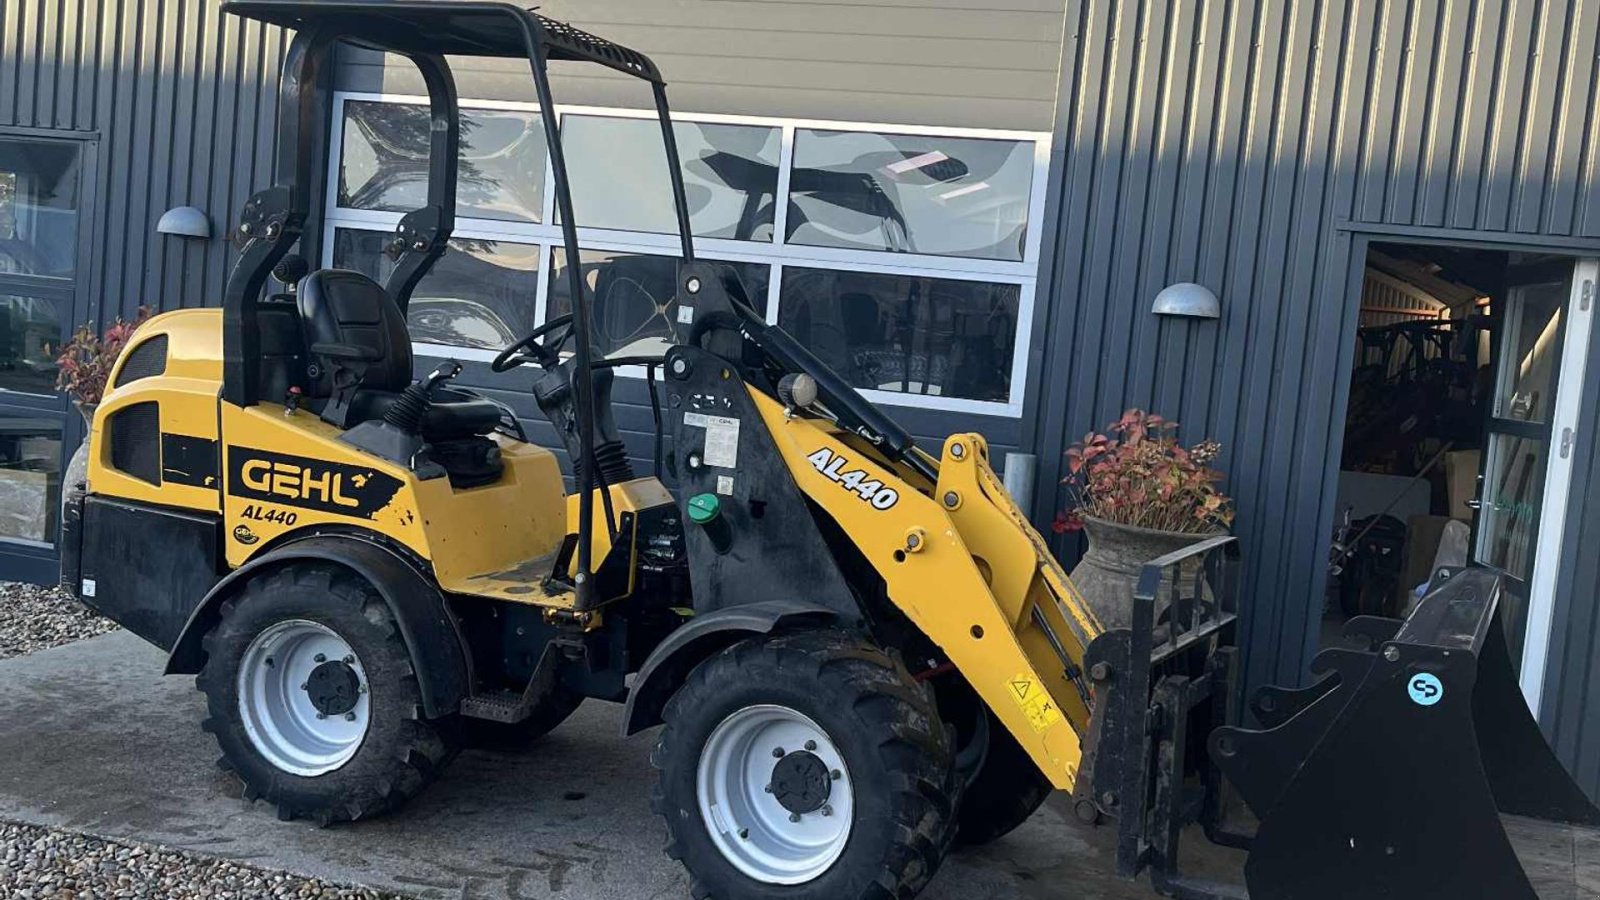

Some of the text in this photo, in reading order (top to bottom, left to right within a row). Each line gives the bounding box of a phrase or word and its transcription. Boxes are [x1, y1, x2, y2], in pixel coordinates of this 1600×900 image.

[241, 459, 359, 507] GEHL
[807, 447, 899, 510] AL440
[240, 505, 297, 526] AL440
